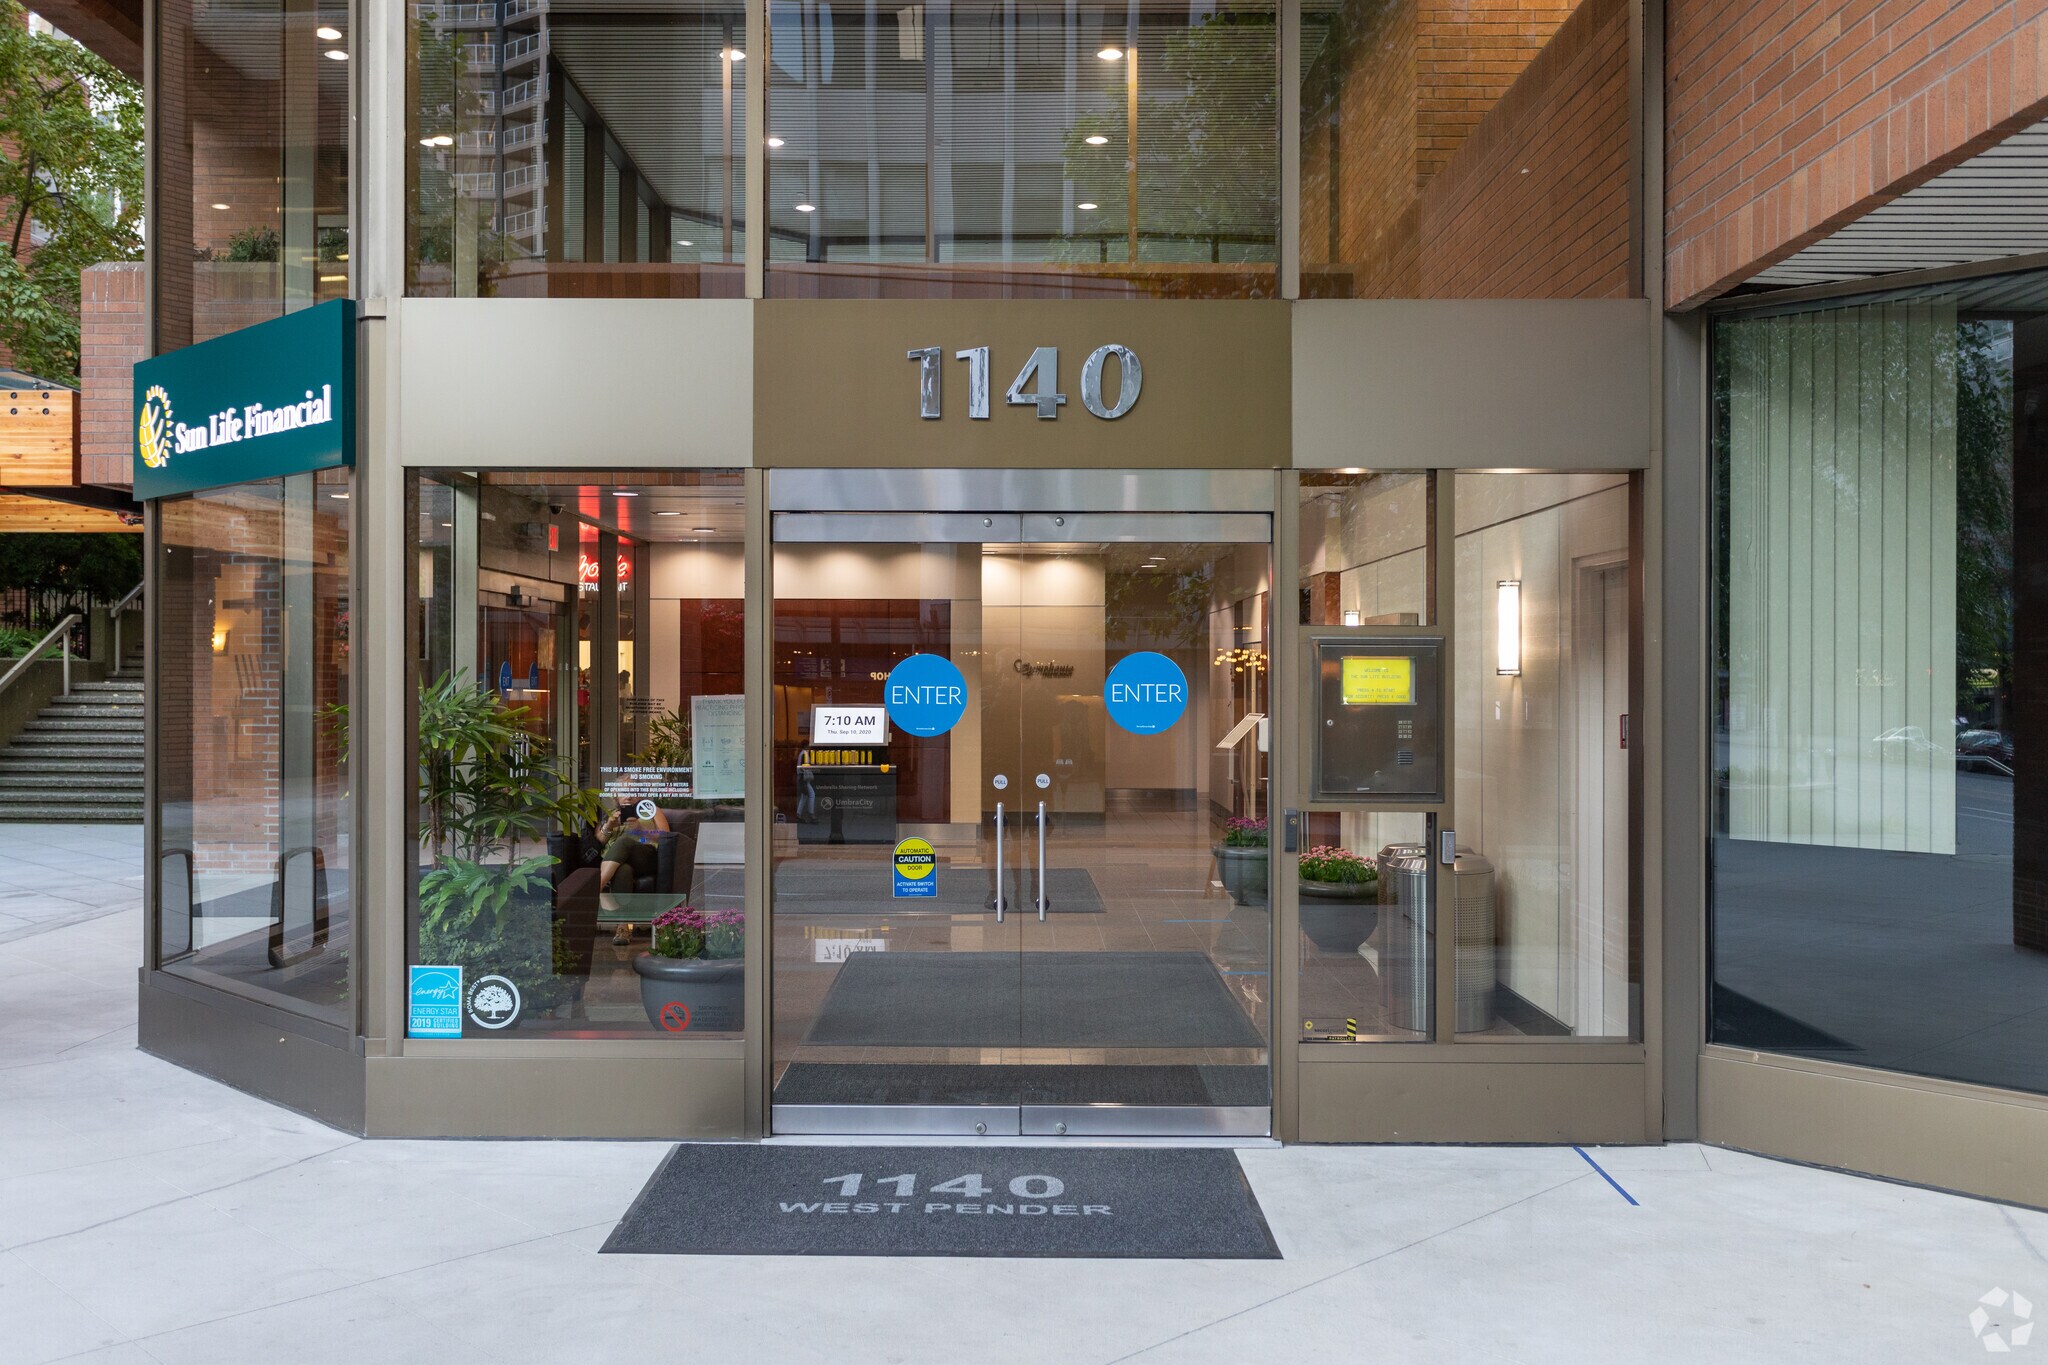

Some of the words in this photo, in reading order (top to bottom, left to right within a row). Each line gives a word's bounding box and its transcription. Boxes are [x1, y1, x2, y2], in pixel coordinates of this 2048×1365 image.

[907, 345, 1143, 419] 1140
[175, 422, 208, 454] Sun
[209, 407, 243, 447] Life
[243, 384, 332, 439] Financial
[892, 686, 961, 704] ENTER
[1112, 684, 1182, 702] ENTER
[824, 716, 851, 726] 7:10
[855, 716, 876, 726] AM
[412, 1007, 439, 1015] ENERGY
[440, 1007, 458, 1015] STAR
[411, 1018, 431, 1028] 2019
[822, 1173, 1065, 1199] 1140
[779, 1203, 910, 1214] WEST
[924, 1203, 1114, 1216] PENDER
